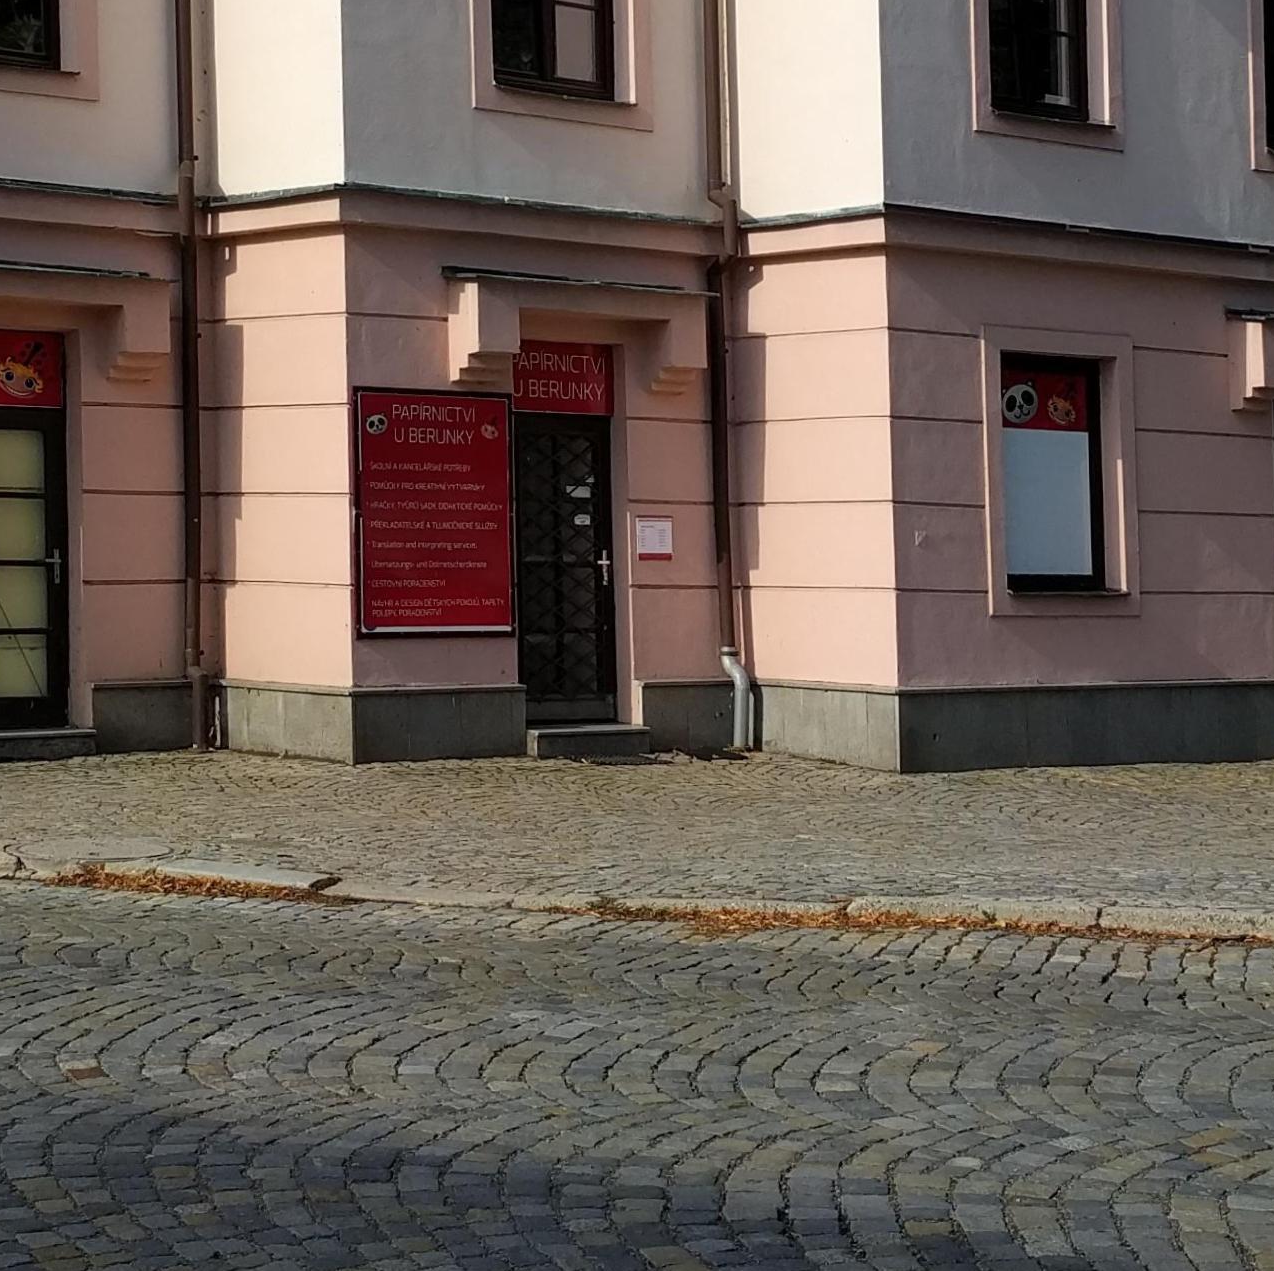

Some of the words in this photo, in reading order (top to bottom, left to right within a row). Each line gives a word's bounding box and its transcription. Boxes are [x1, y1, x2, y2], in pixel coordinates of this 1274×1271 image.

[528, 379, 605, 401] BERUNKY
[392, 402, 476, 423] PAPÍRNICTVÍ
[394, 429, 405, 443] U
[409, 428, 475, 445] BERUNKY
